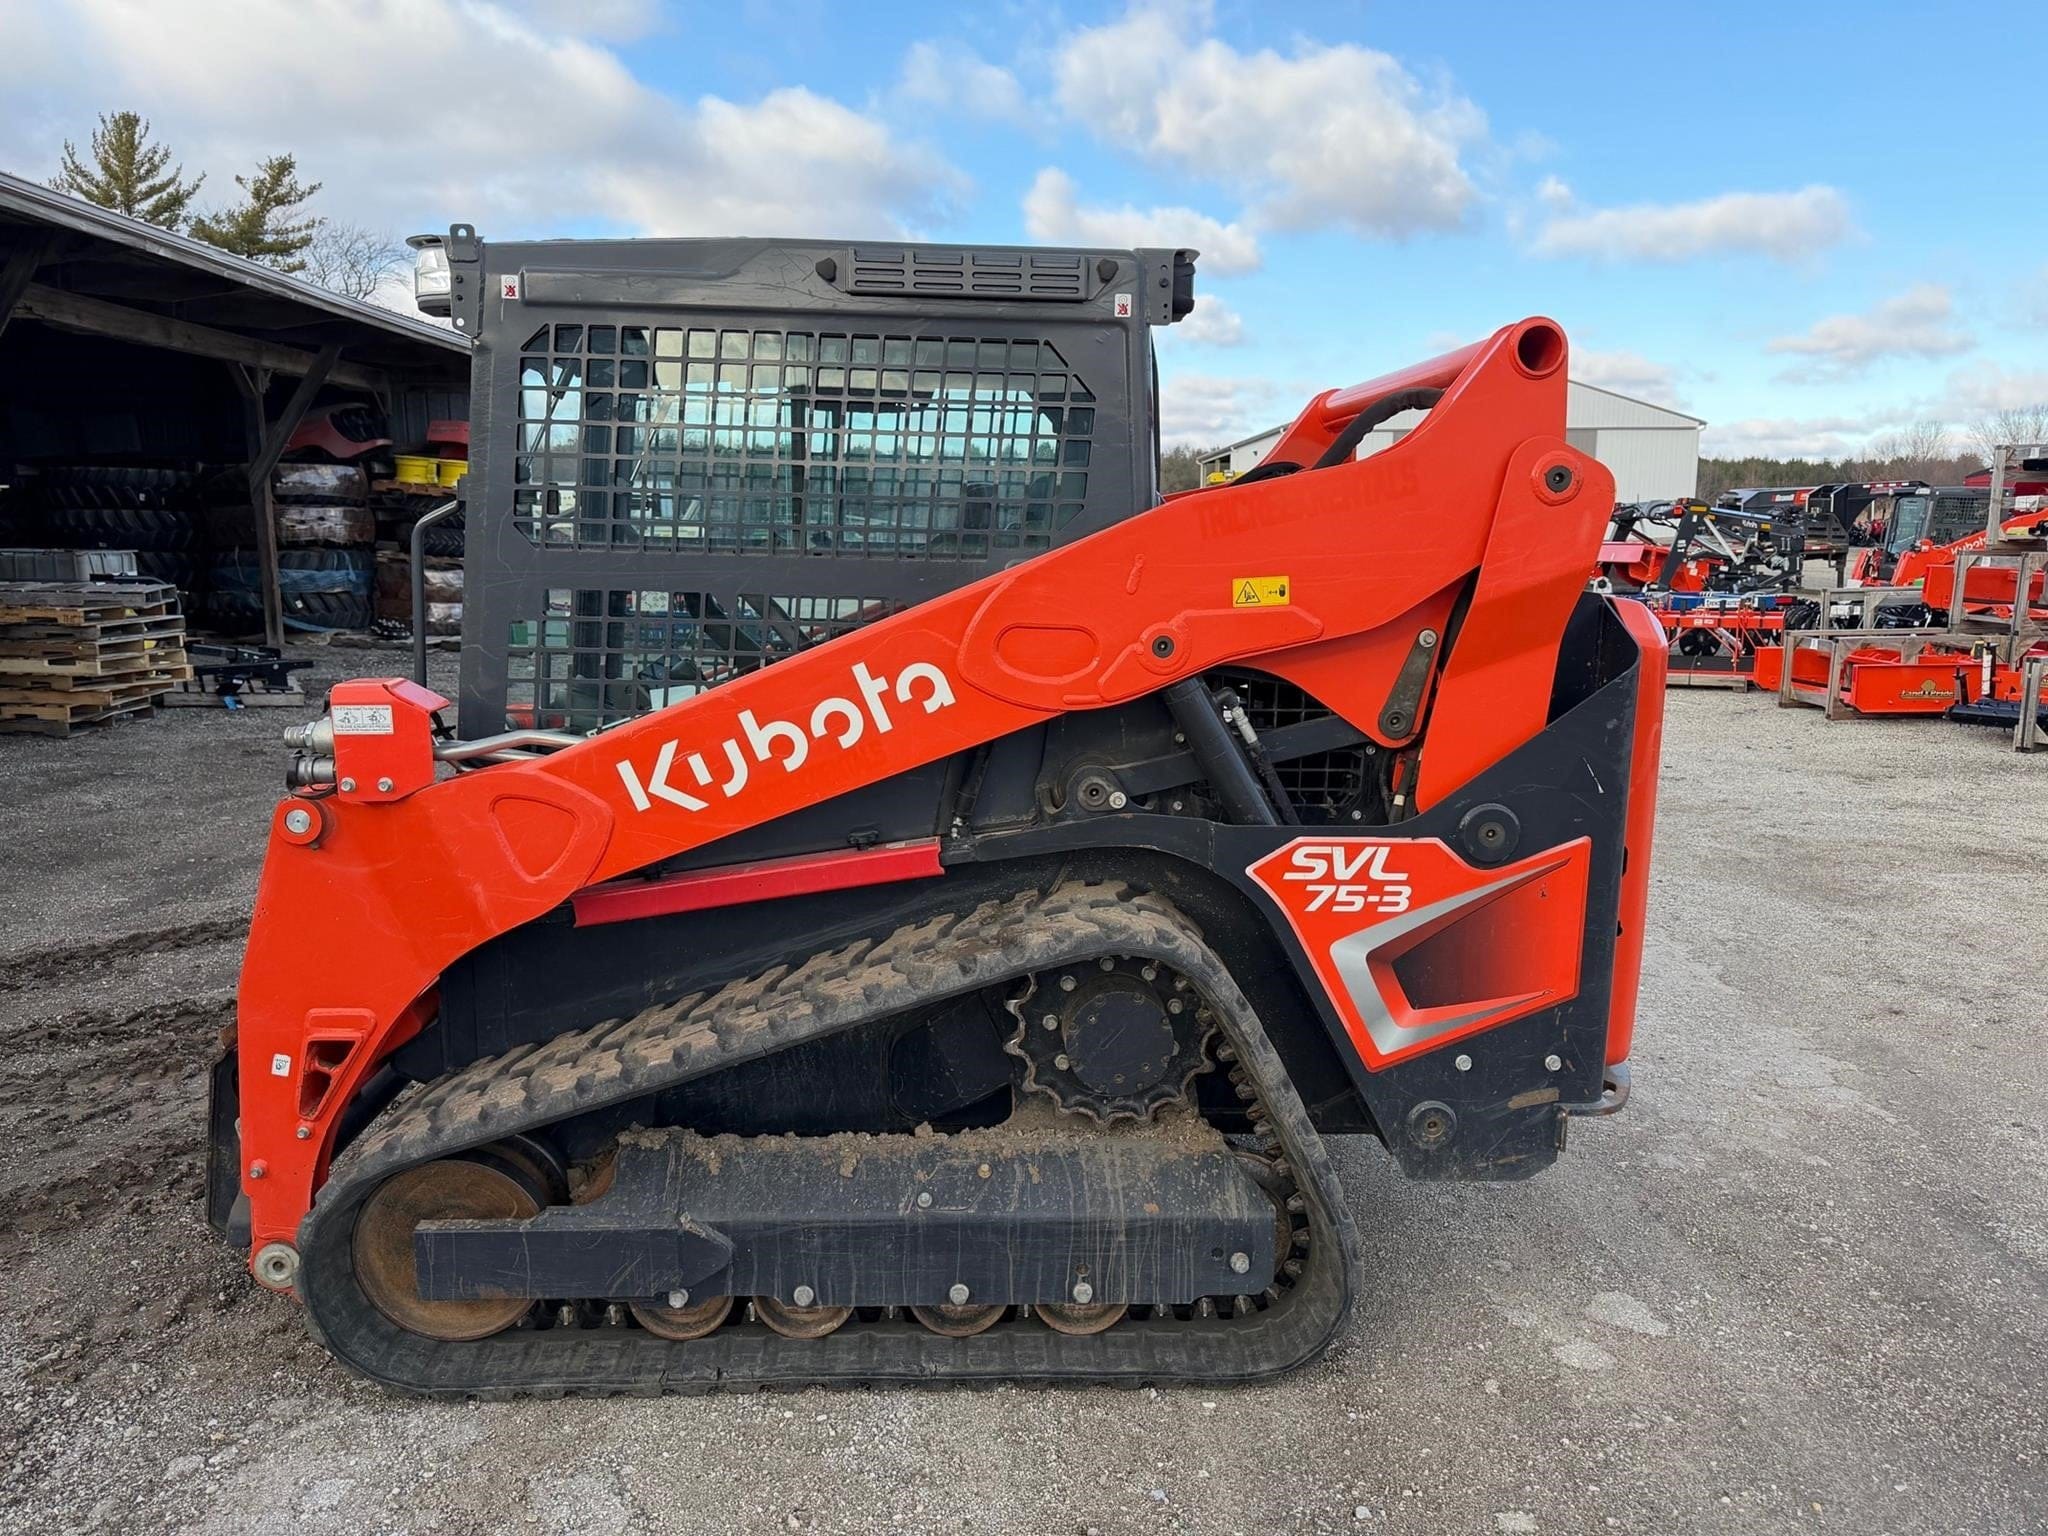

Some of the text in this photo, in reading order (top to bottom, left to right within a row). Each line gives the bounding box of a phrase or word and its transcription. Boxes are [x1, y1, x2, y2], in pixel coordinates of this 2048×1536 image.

[615, 662, 956, 812] Kubota
[1282, 846, 1409, 881] SVL
[1304, 885, 1412, 912] 75-3
